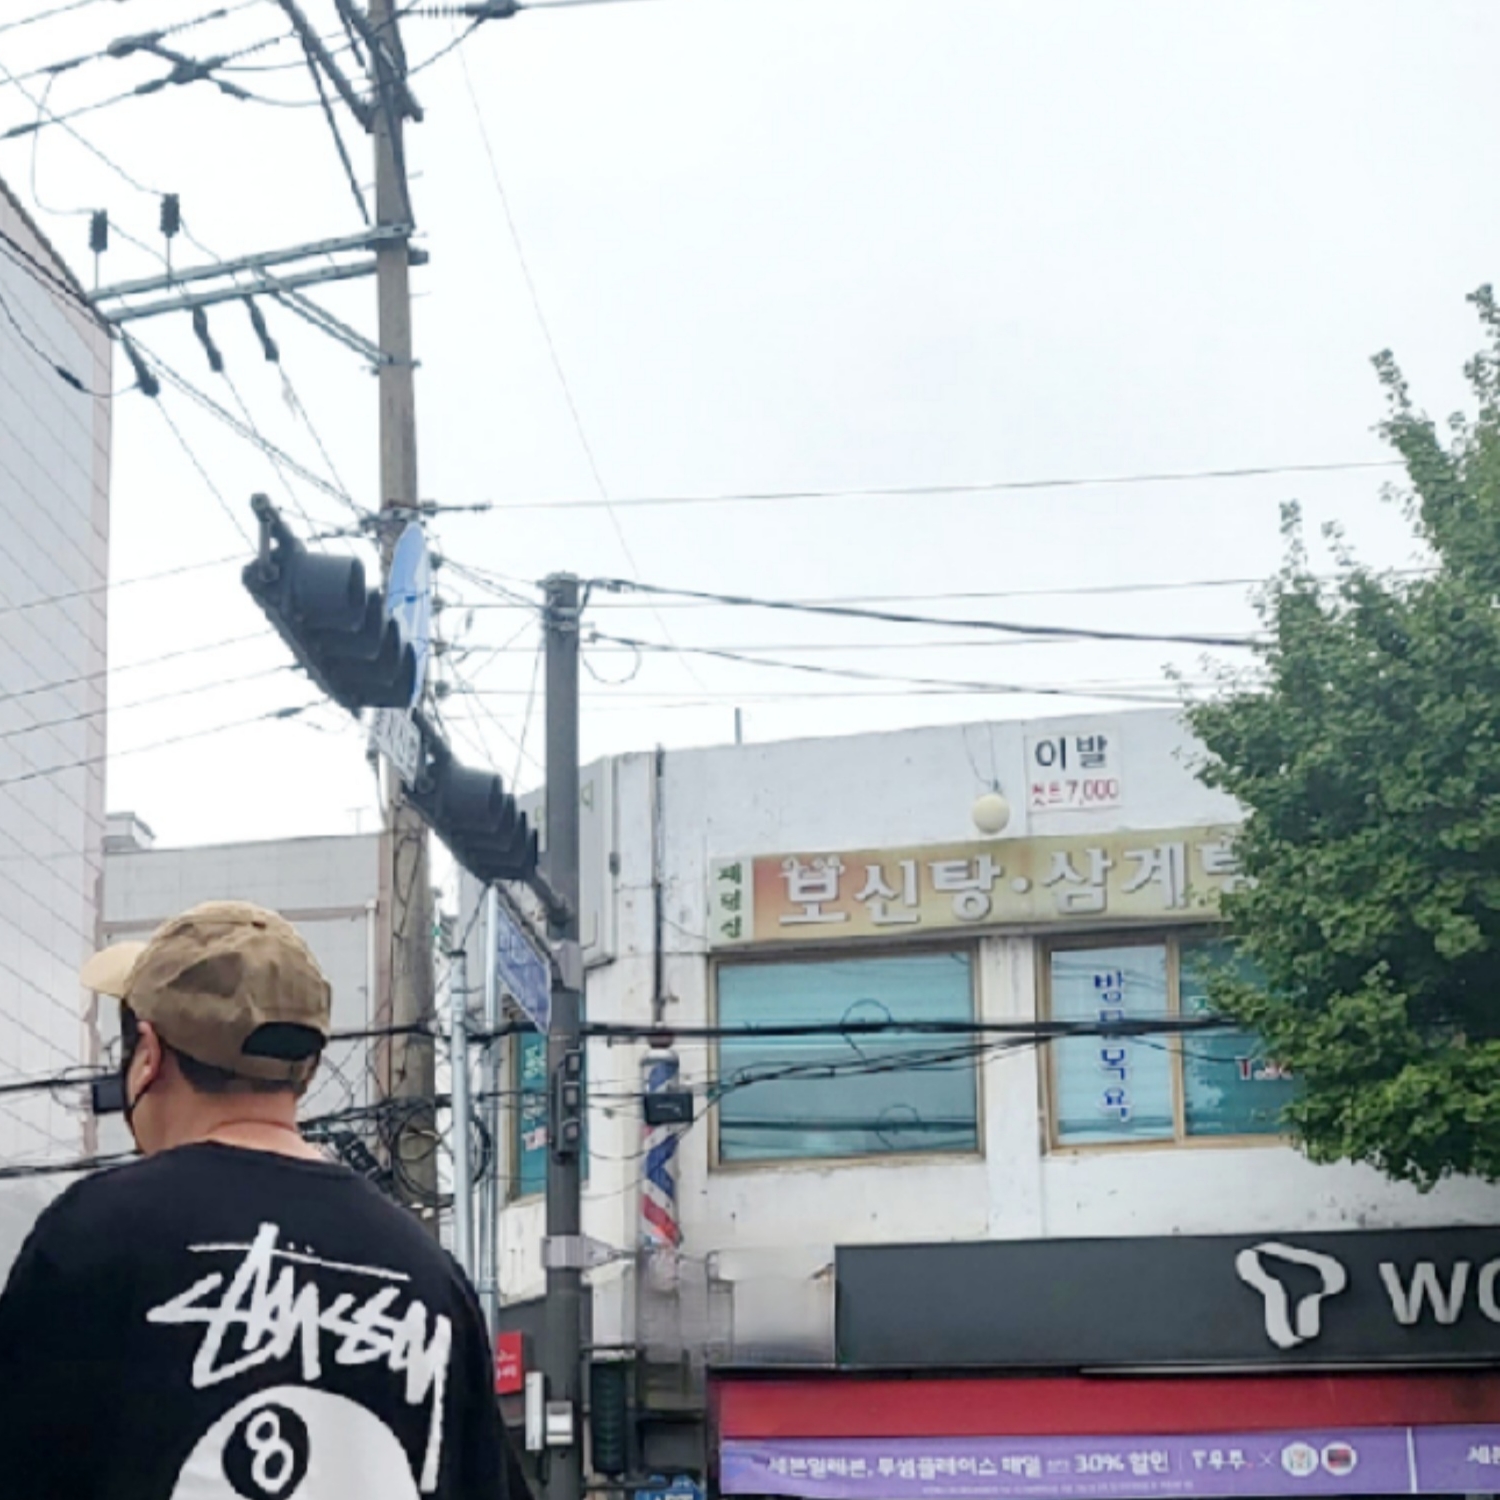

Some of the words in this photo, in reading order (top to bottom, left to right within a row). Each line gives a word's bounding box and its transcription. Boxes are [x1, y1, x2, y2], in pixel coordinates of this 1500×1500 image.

[1035, 735, 1108, 770] 이발
[246, 1411, 294, 1493] 8
[1074, 1454, 1125, 1473] 30%
[1127, 1450, 1169, 1476] 할인
